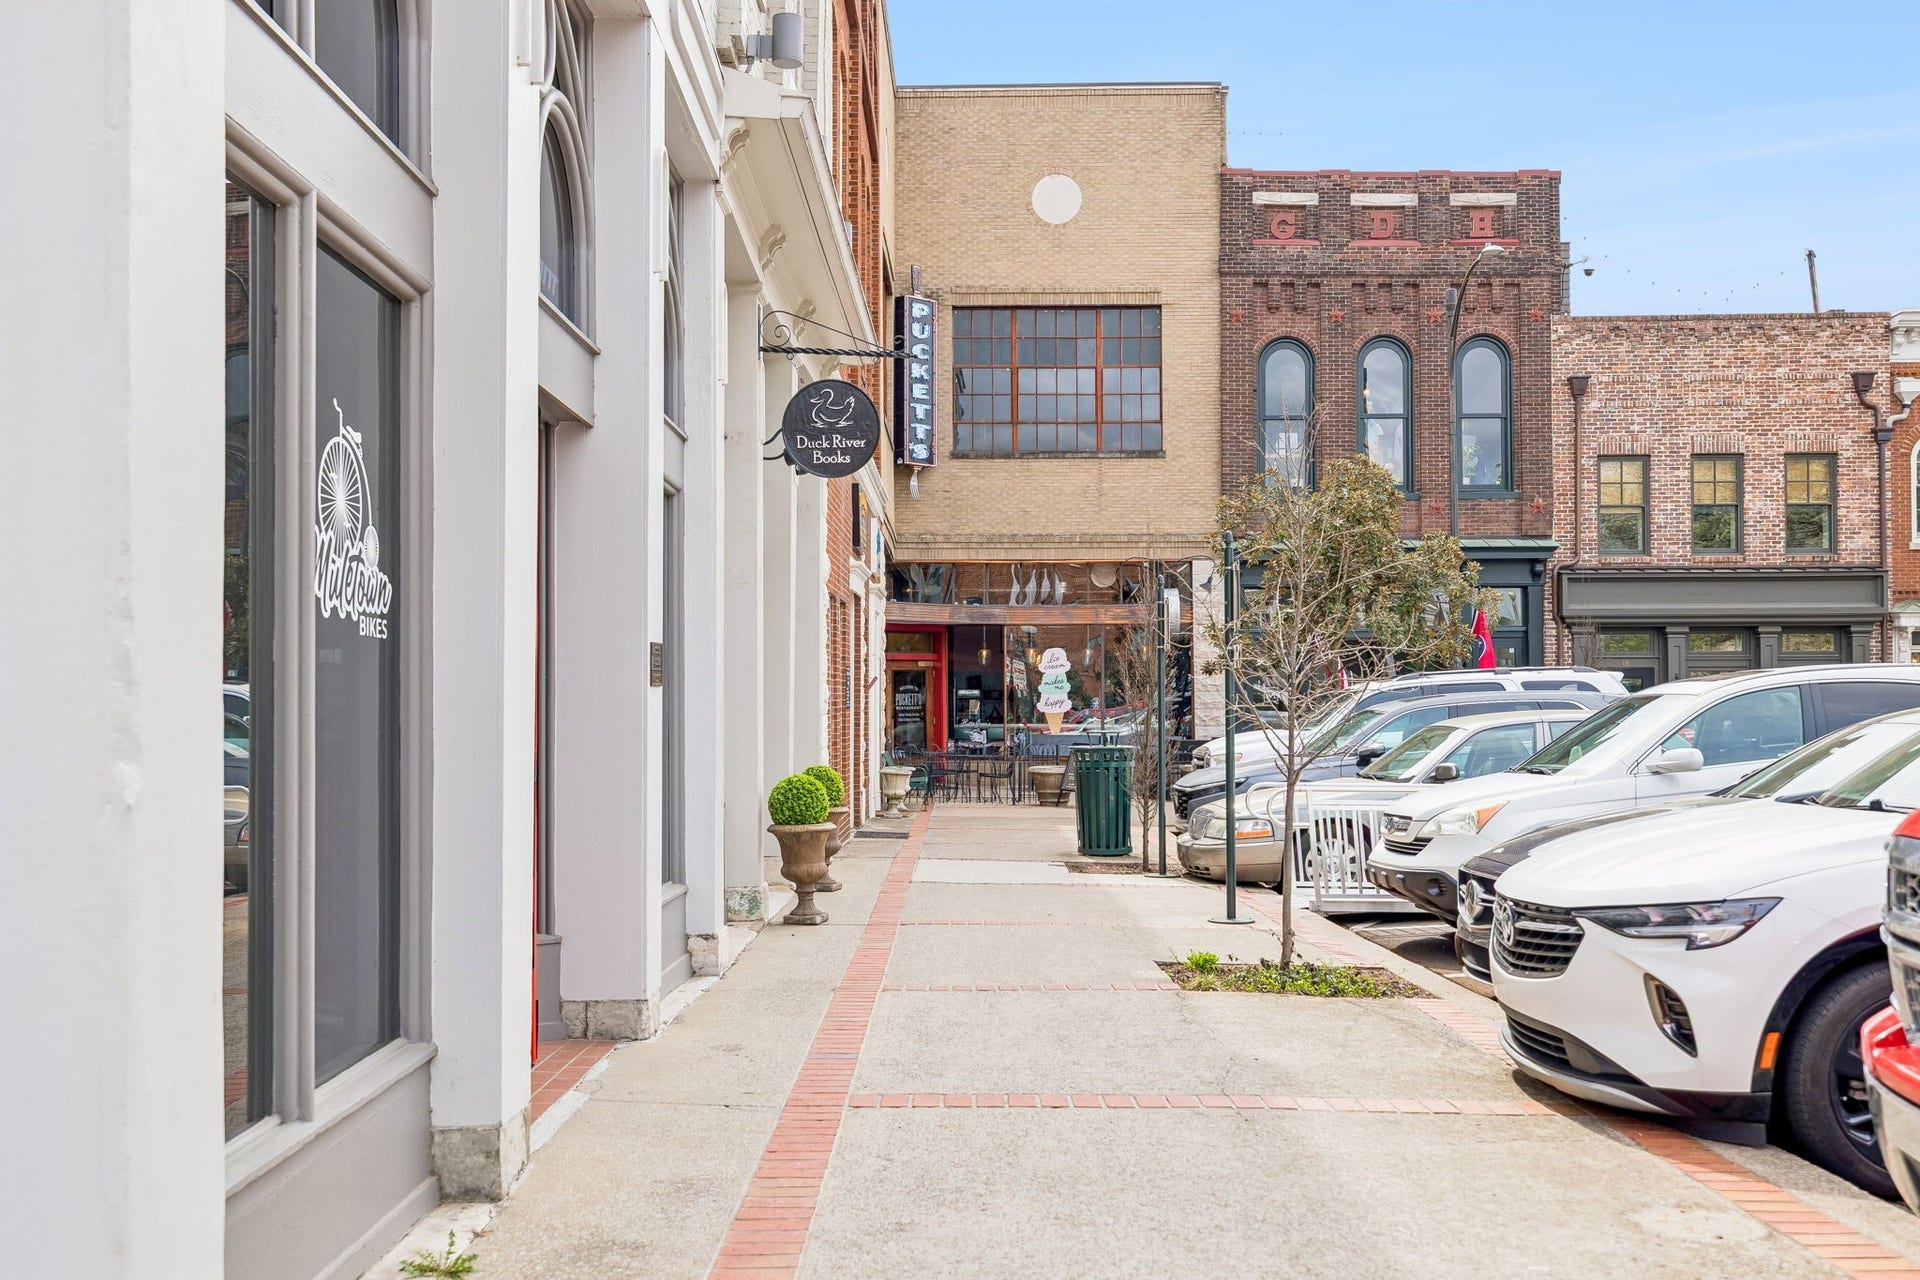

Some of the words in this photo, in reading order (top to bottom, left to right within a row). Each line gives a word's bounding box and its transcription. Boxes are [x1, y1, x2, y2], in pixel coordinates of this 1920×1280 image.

[1370, 211, 1395, 238] D
[1469, 211, 1495, 237] H
[908, 301, 931, 461] PUCKETT'S
[796, 435, 830, 449] Duck
[831, 434, 866, 448] River
[812, 450, 851, 464] Books
[359, 615, 388, 639] BIKES
[1043, 697, 1066, 708] happy
